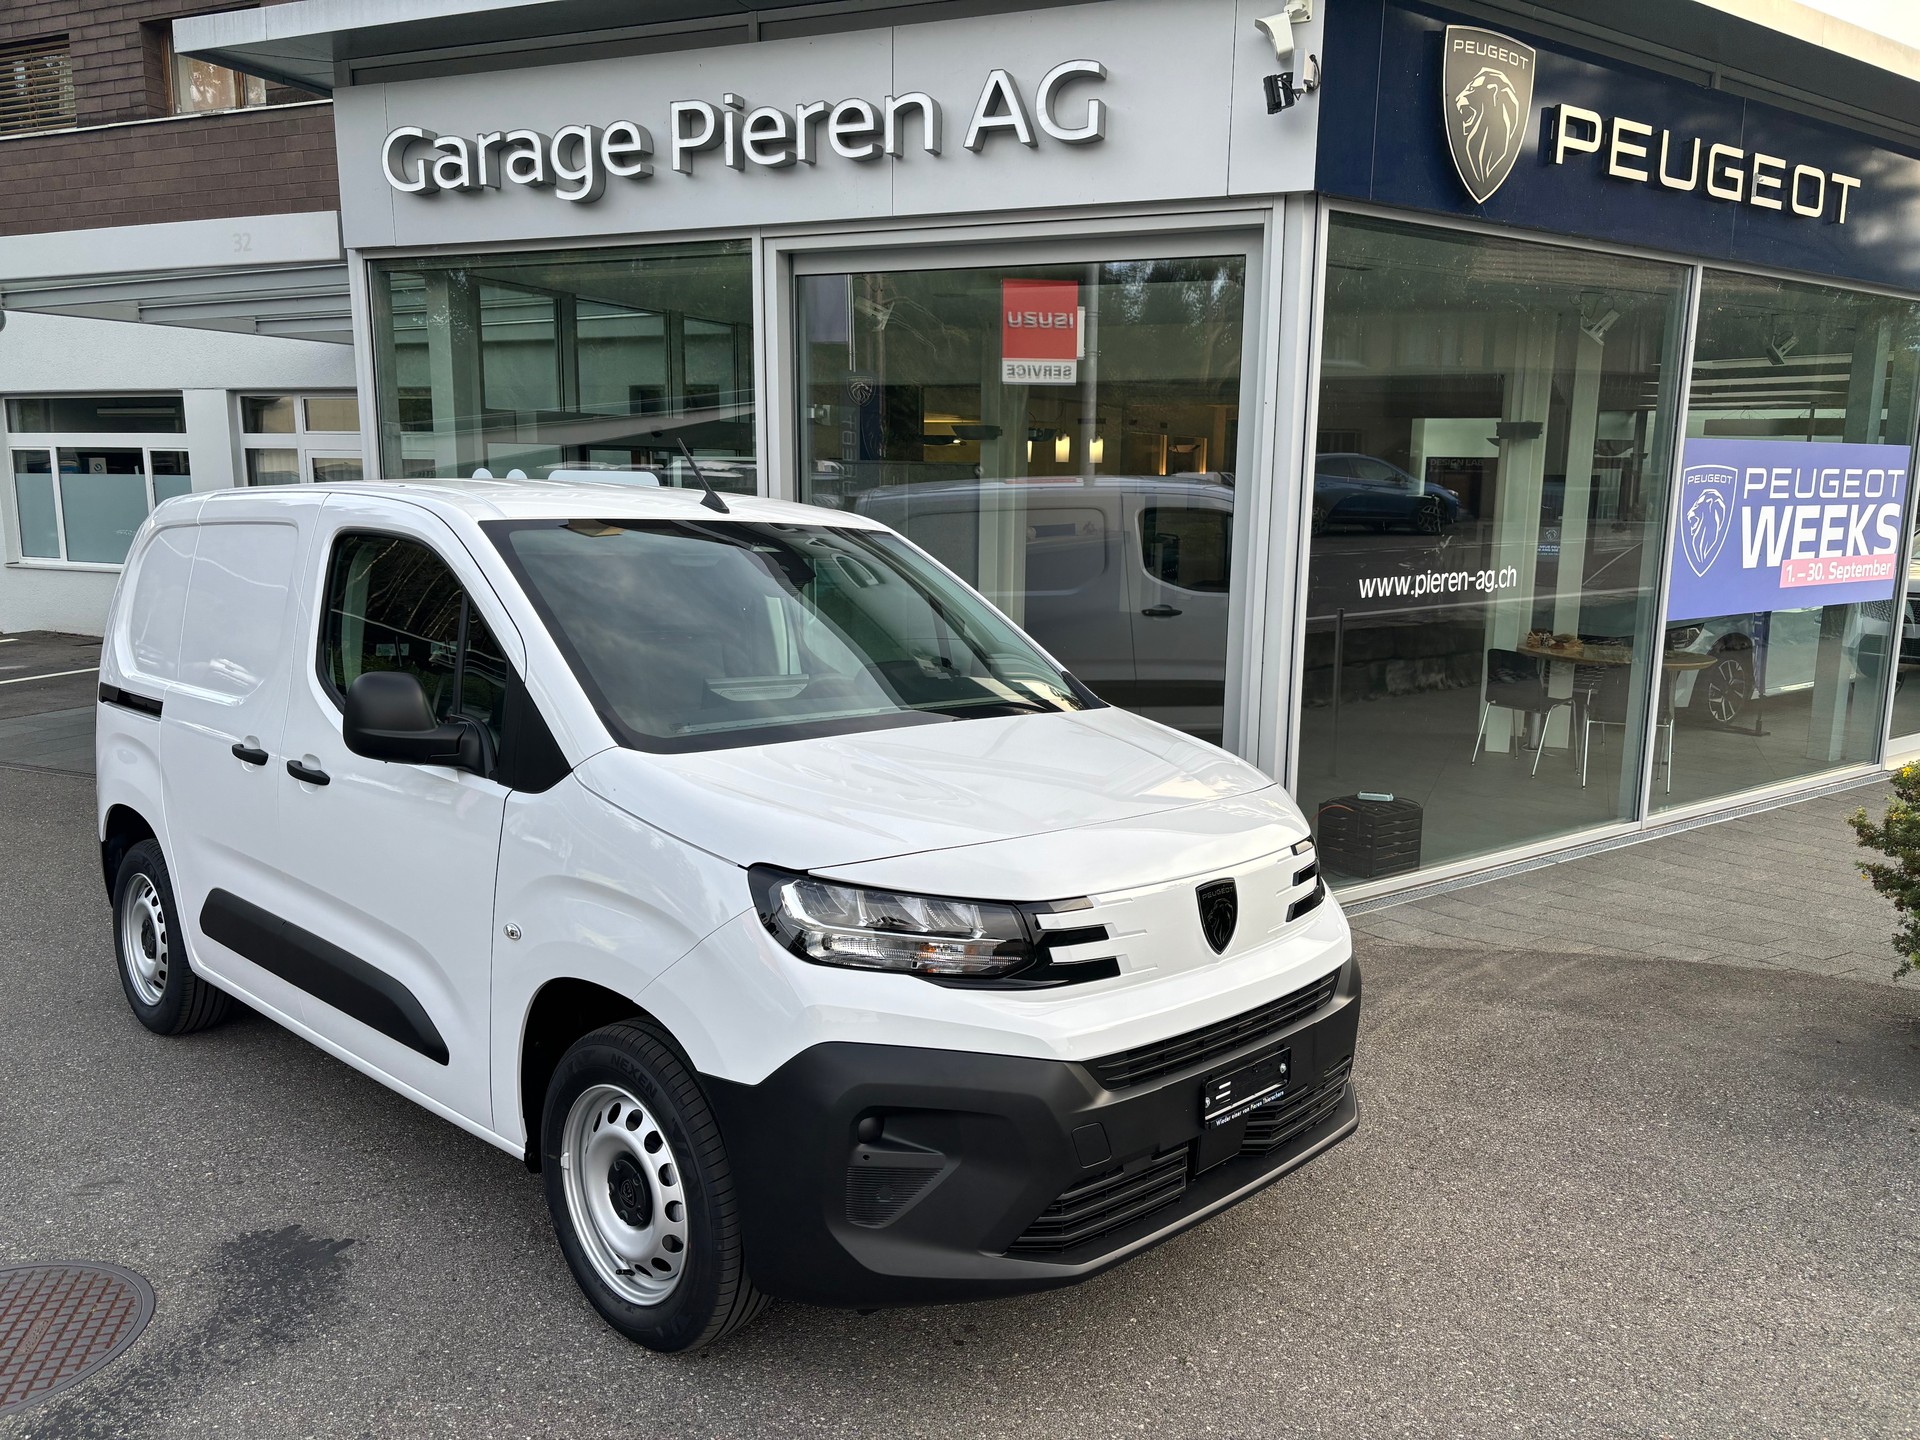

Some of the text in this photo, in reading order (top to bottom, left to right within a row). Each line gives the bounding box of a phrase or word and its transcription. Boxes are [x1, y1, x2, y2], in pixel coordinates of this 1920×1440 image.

[1453, 39, 1529, 70] PEUGEOT
[381, 59, 1107, 202] Garage Pieren AG
[1555, 103, 1862, 224] PEUGEOT
[232, 232, 253, 252] 32
[1687, 474, 1733, 485] PEUGEOT
[1743, 467, 1905, 500] PEUGEOT
[1741, 503, 1901, 569] WEEKS
[1358, 565, 1517, 599] www.pieren-ag.ch
[1828, 561, 1892, 582] September
[1202, 886, 1233, 900] PEUGEOT
[611, 1052, 658, 1098] NEXEN
